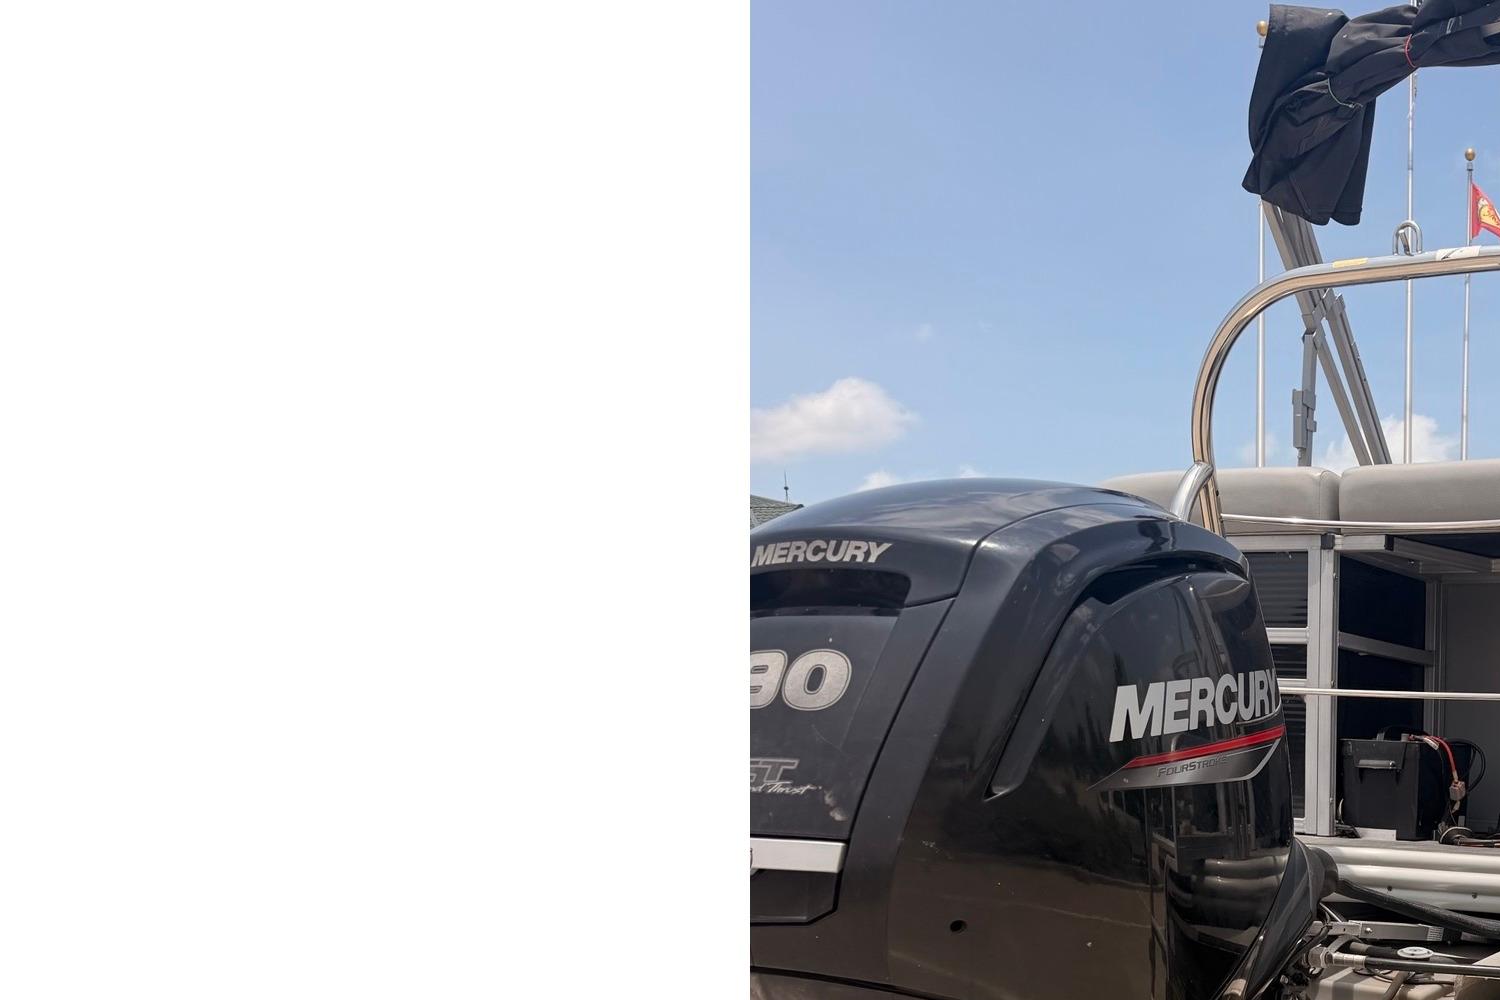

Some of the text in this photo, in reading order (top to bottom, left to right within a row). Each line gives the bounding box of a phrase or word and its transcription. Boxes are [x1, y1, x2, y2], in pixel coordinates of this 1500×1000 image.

[750, 540, 893, 567] MERCURY
[750, 649, 852, 711] 90
[1109, 669, 1277, 743] MERCURY
